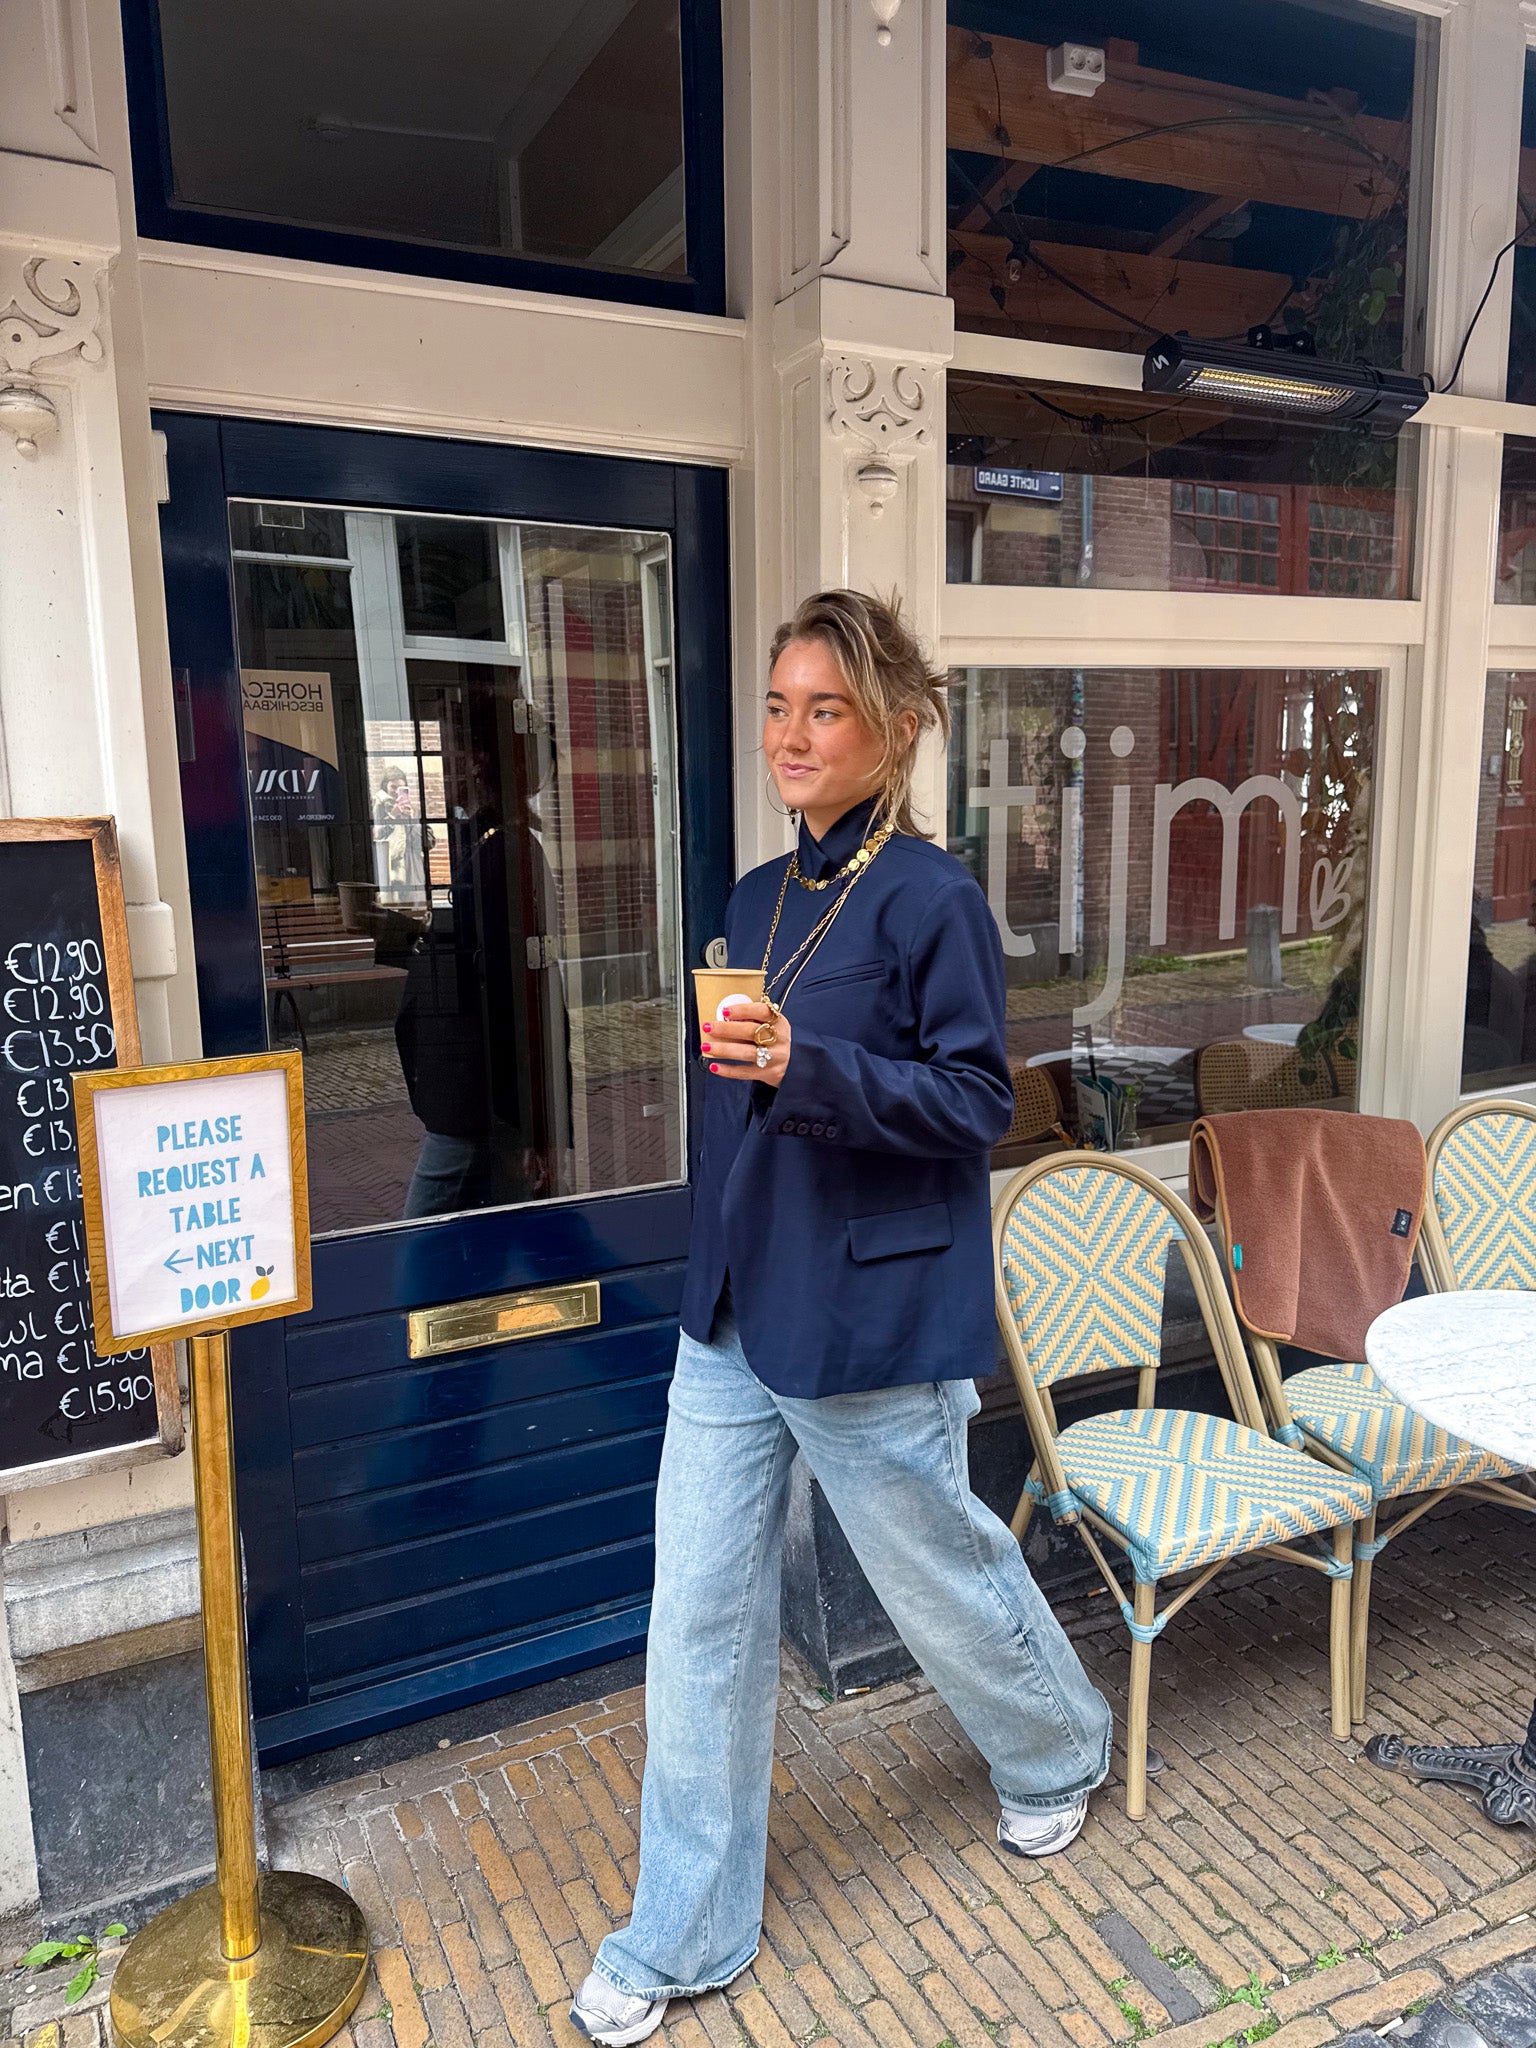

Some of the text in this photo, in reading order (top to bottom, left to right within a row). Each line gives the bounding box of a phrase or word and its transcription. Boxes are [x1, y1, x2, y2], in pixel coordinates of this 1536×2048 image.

[969, 726, 1303, 1027] tijm
[157, 1115, 242, 1152] PLEASE
[137, 1153, 266, 1198] REQUEST A
[169, 1197, 241, 1233] TABLE
[196, 1235, 255, 1270] NEXT
[180, 1278, 241, 1313] DOOR
